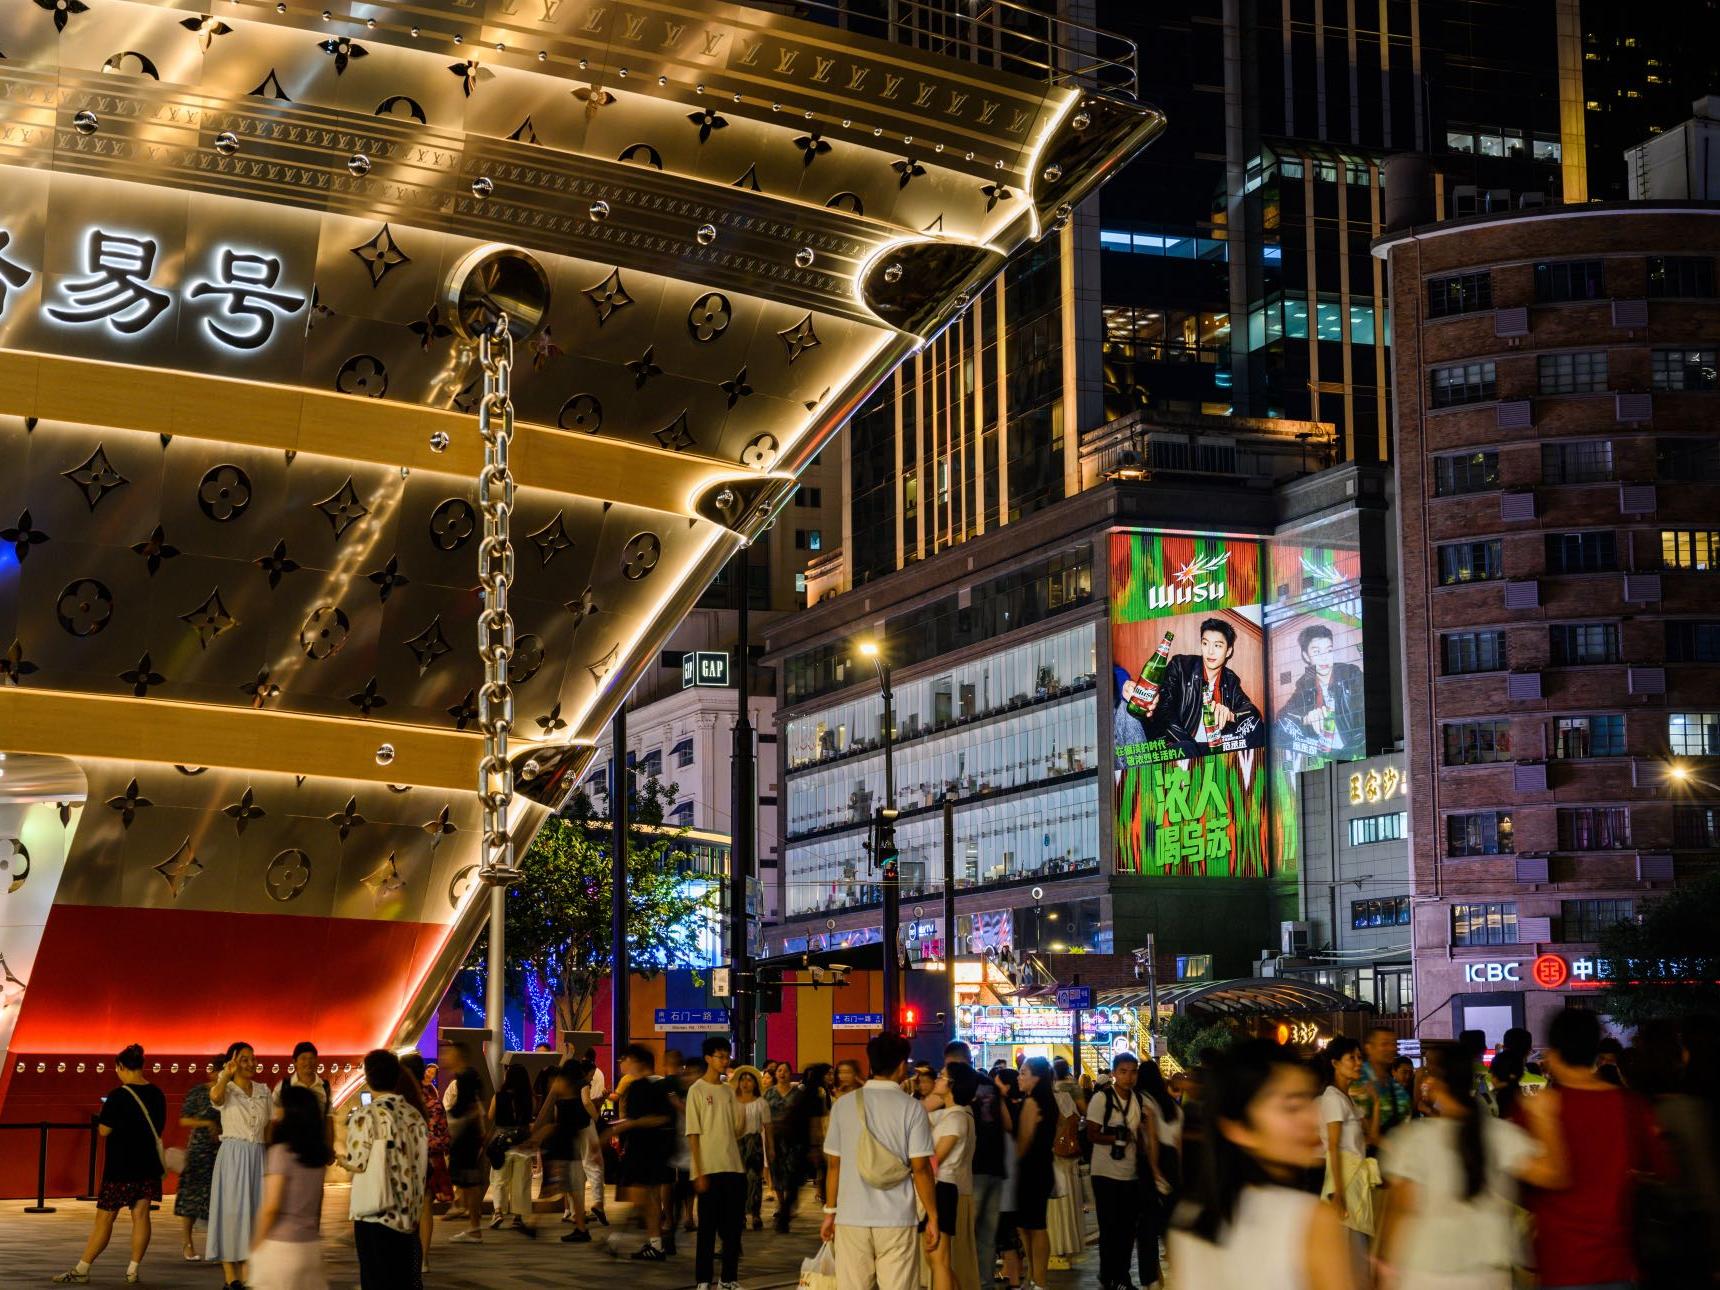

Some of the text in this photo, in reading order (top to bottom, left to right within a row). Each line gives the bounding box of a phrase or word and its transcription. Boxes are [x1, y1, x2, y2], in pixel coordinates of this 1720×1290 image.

[1148, 582, 1226, 610] Wusu
[702, 660, 723, 677] GAP
[1155, 761, 1229, 825] 浓人
[1350, 767, 1398, 804] 王家沙
[1155, 817, 1232, 867] 喝乌苏
[1466, 963, 1519, 982] ICBC
[671, 1011, 712, 1022] 石门一路
